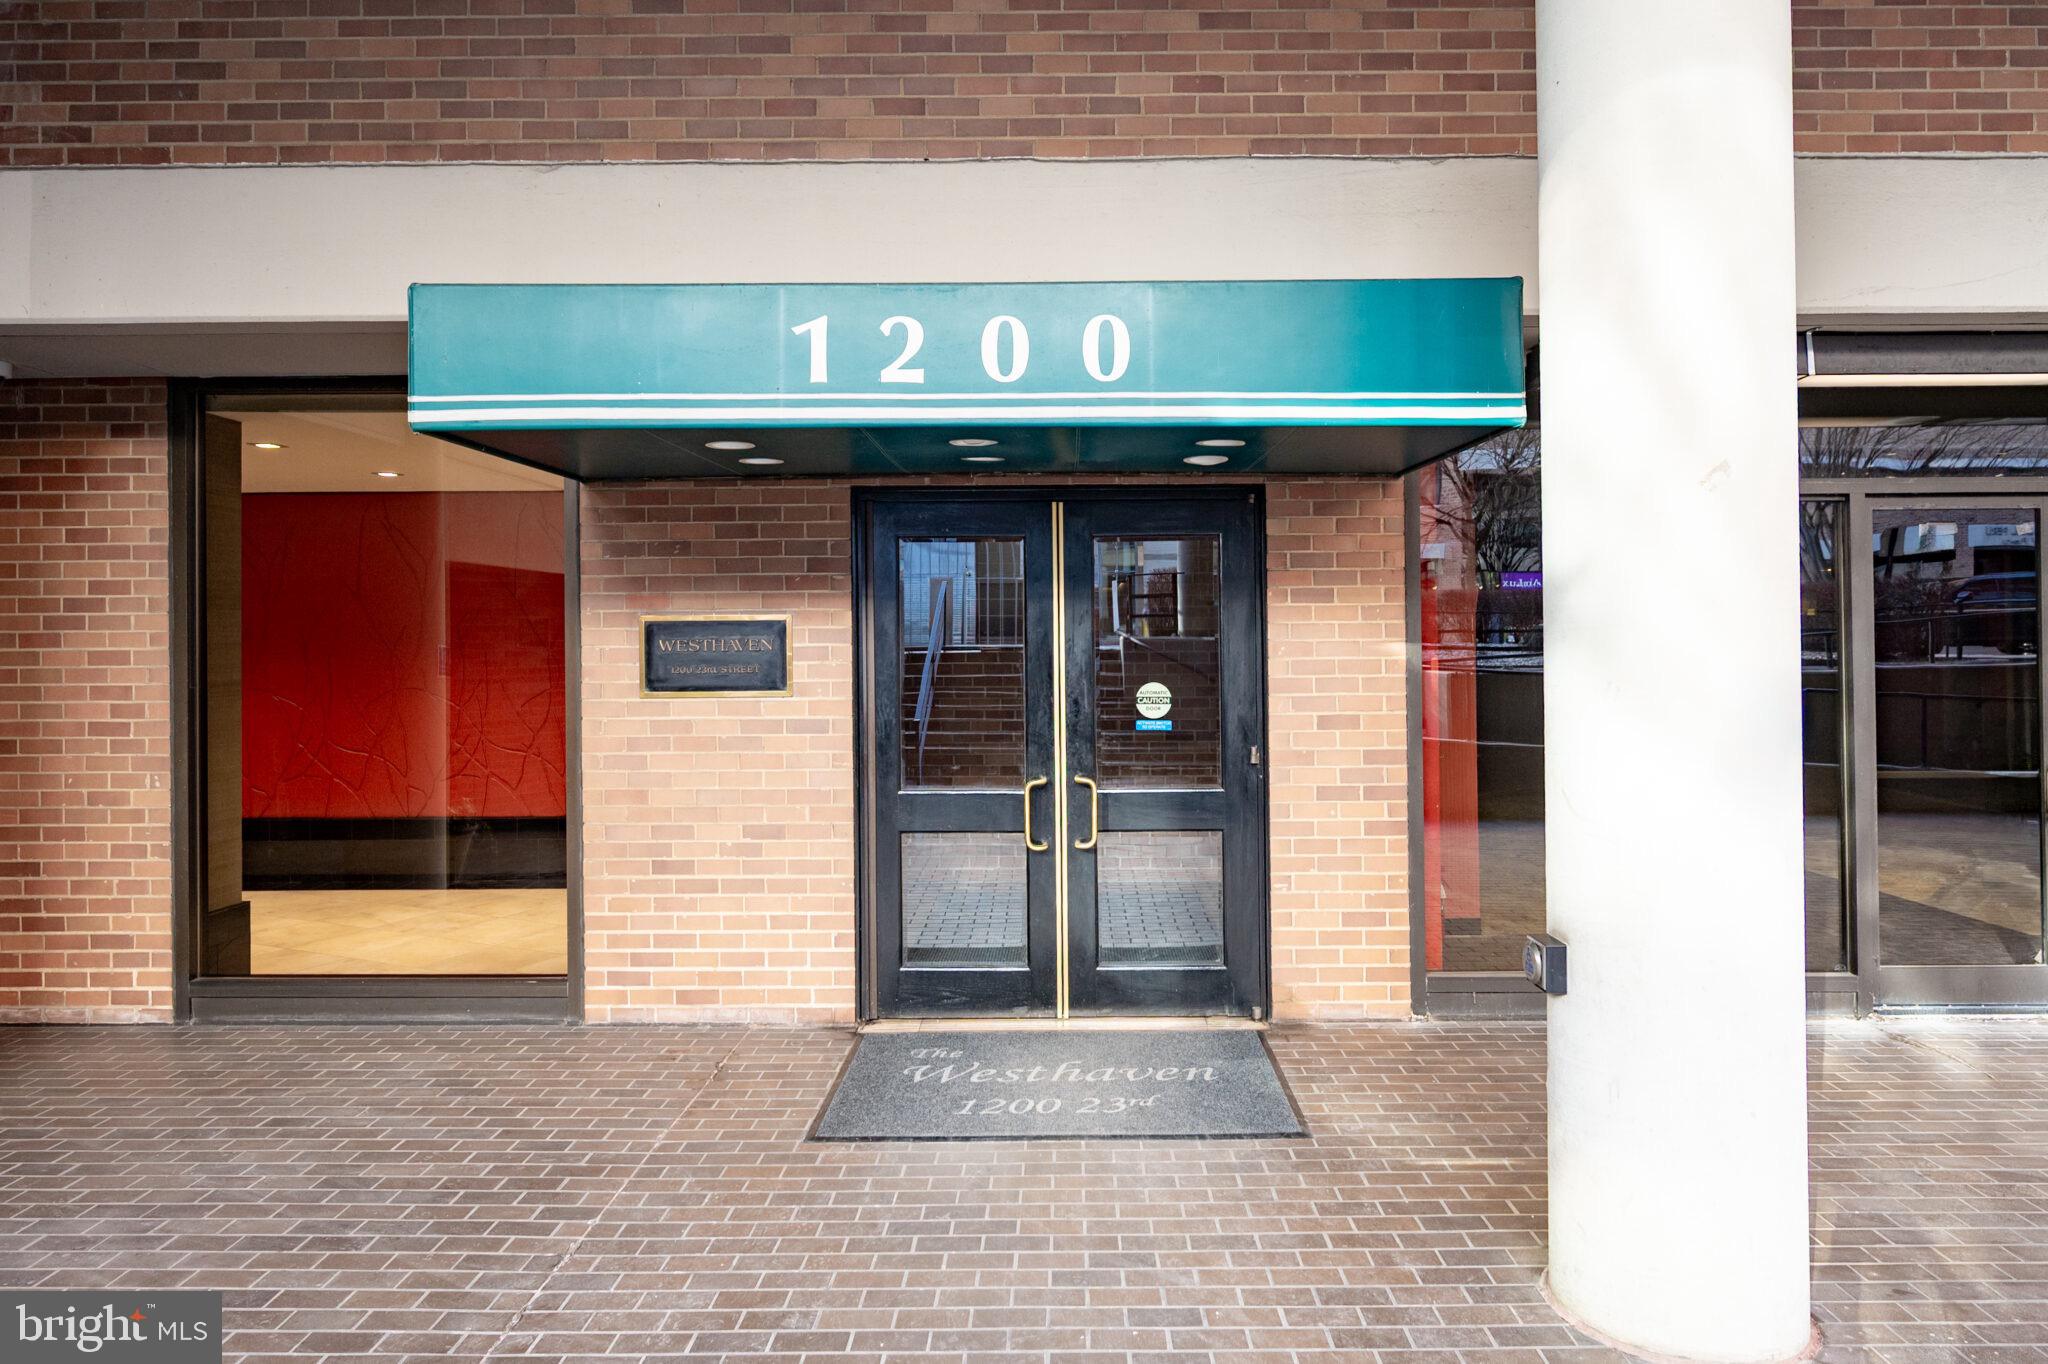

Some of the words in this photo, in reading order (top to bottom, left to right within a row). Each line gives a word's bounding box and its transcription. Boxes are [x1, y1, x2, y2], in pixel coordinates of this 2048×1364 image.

[790, 314, 1131, 384] 1200
[658, 639, 774, 652] WESTHAVEN
[671, 665, 694, 674] 1200
[720, 664, 761, 674] STREET
[910, 1047, 964, 1059] The
[903, 1061, 1218, 1084] Westhaven
[953, 1098, 1062, 1115] 1200
[1075, 1094, 1162, 1114] 23rd
